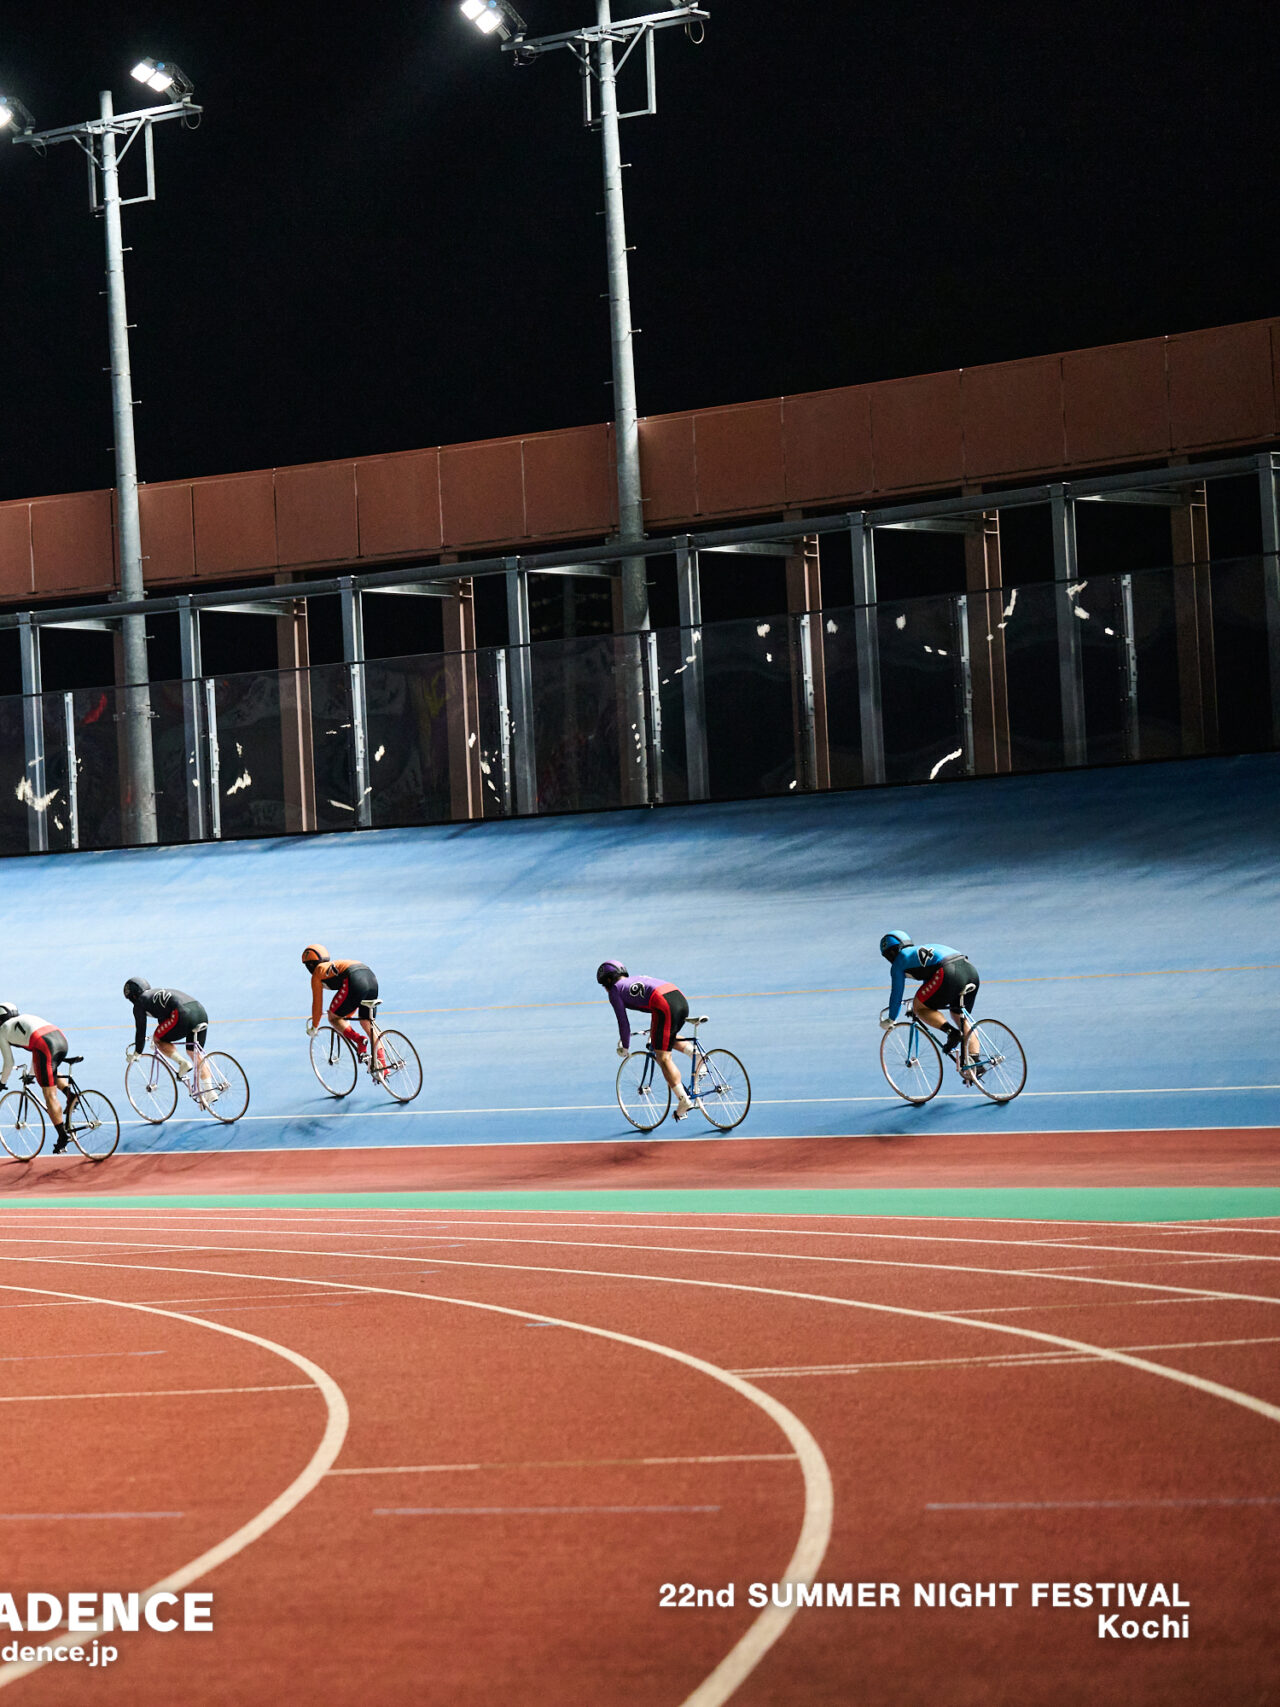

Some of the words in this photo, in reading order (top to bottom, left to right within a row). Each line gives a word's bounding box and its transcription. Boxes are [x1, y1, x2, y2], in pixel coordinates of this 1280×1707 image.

[917, 947, 934, 967] 4
[152, 988, 172, 1008] 2
[629, 982, 645, 998] 9
